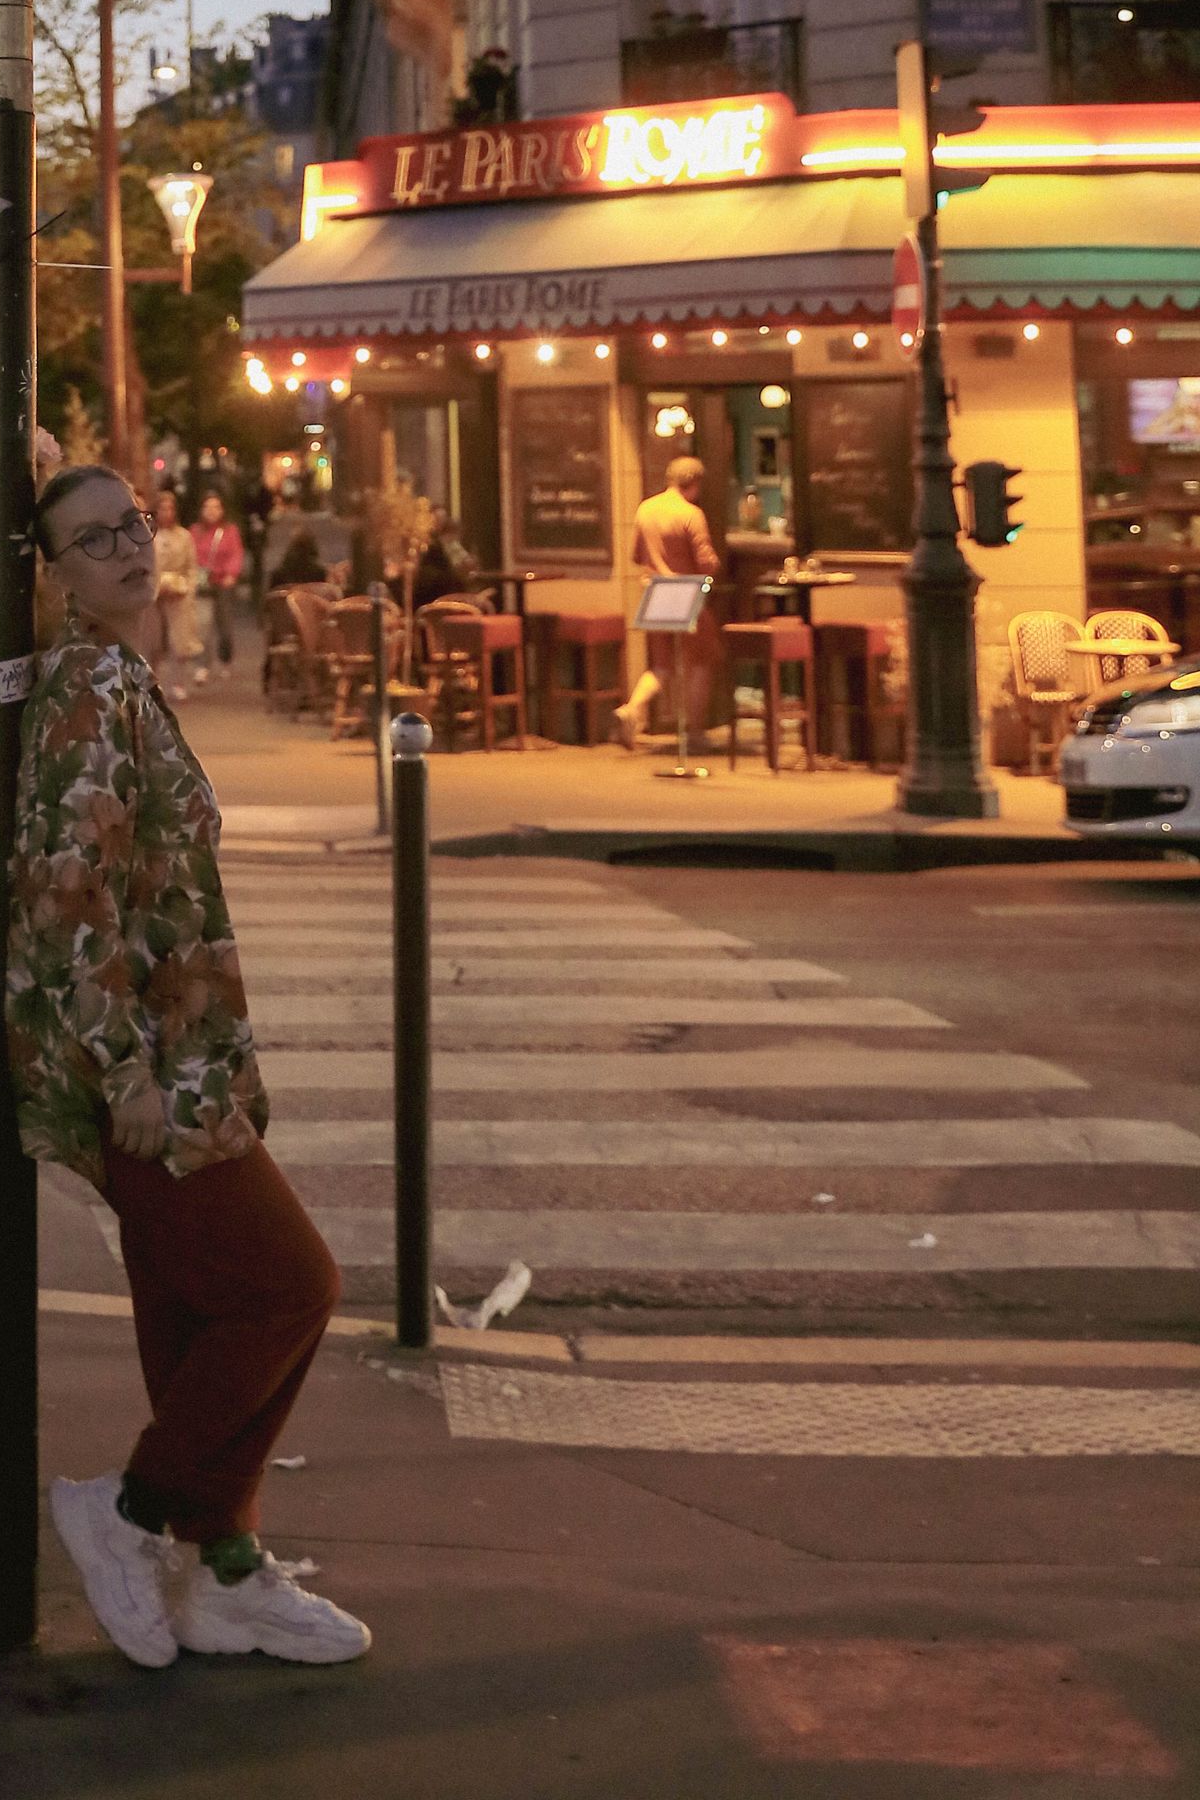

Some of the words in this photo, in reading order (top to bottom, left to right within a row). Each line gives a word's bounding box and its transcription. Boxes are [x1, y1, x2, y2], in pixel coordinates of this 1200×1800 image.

[390, 142, 451, 204] LE
[460, 123, 599, 193] PARIS
[599, 105, 765, 185] ROME
